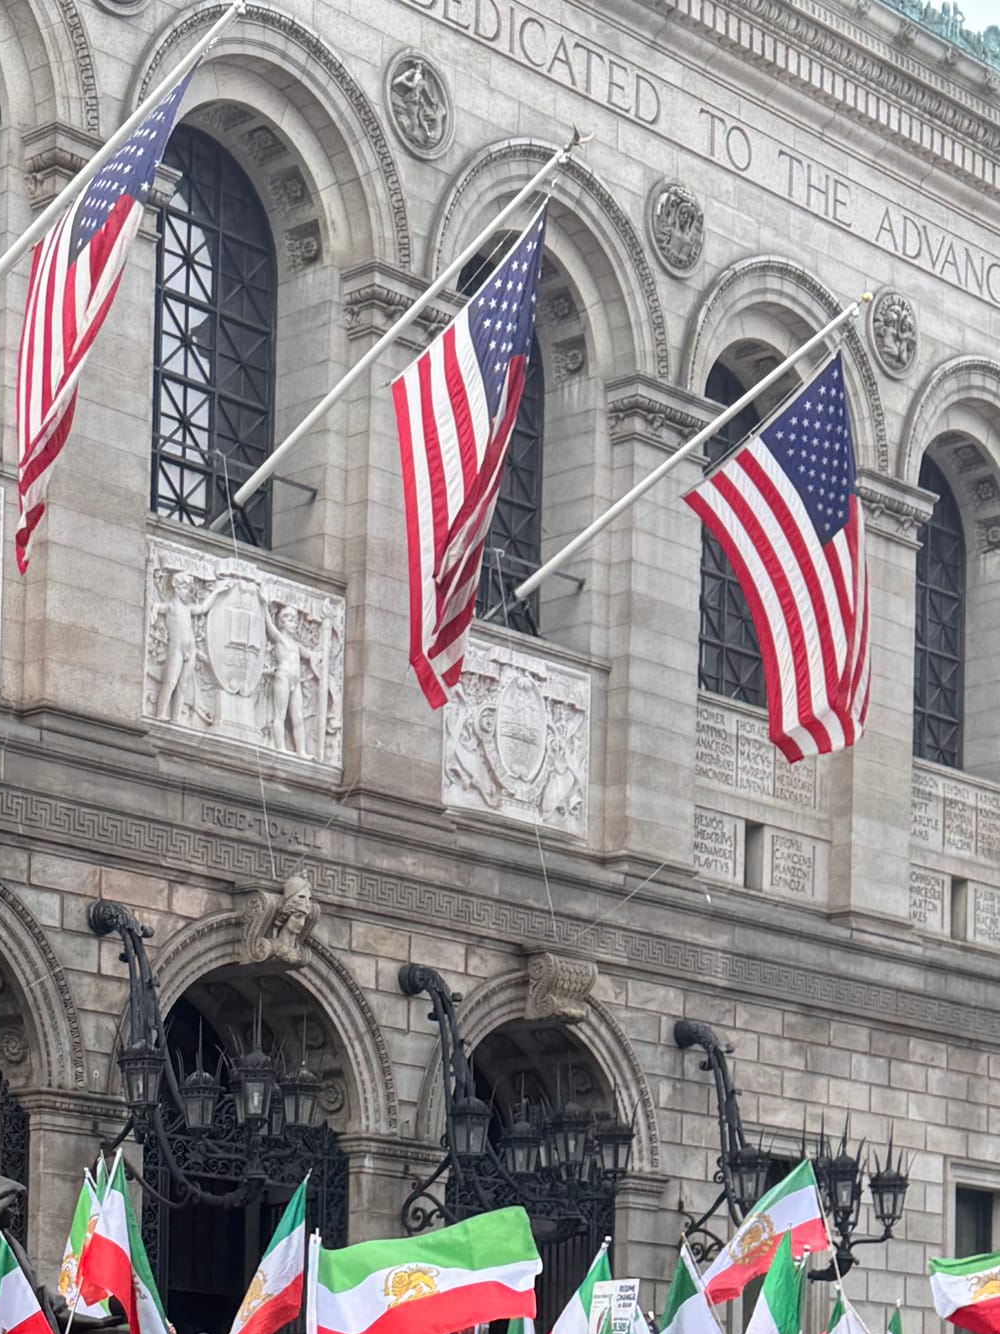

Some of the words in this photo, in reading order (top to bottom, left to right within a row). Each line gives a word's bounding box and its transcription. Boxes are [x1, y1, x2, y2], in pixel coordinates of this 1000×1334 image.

[419, 0, 661, 124] EDICATED
[699, 108, 751, 172] TO
[778, 151, 852, 228] THE
[696, 707, 725, 727] HOMER
[694, 855, 729, 873] PLAVTVS
[774, 863, 811, 880] MANZONI
[774, 874, 805, 893] SPINOZA
